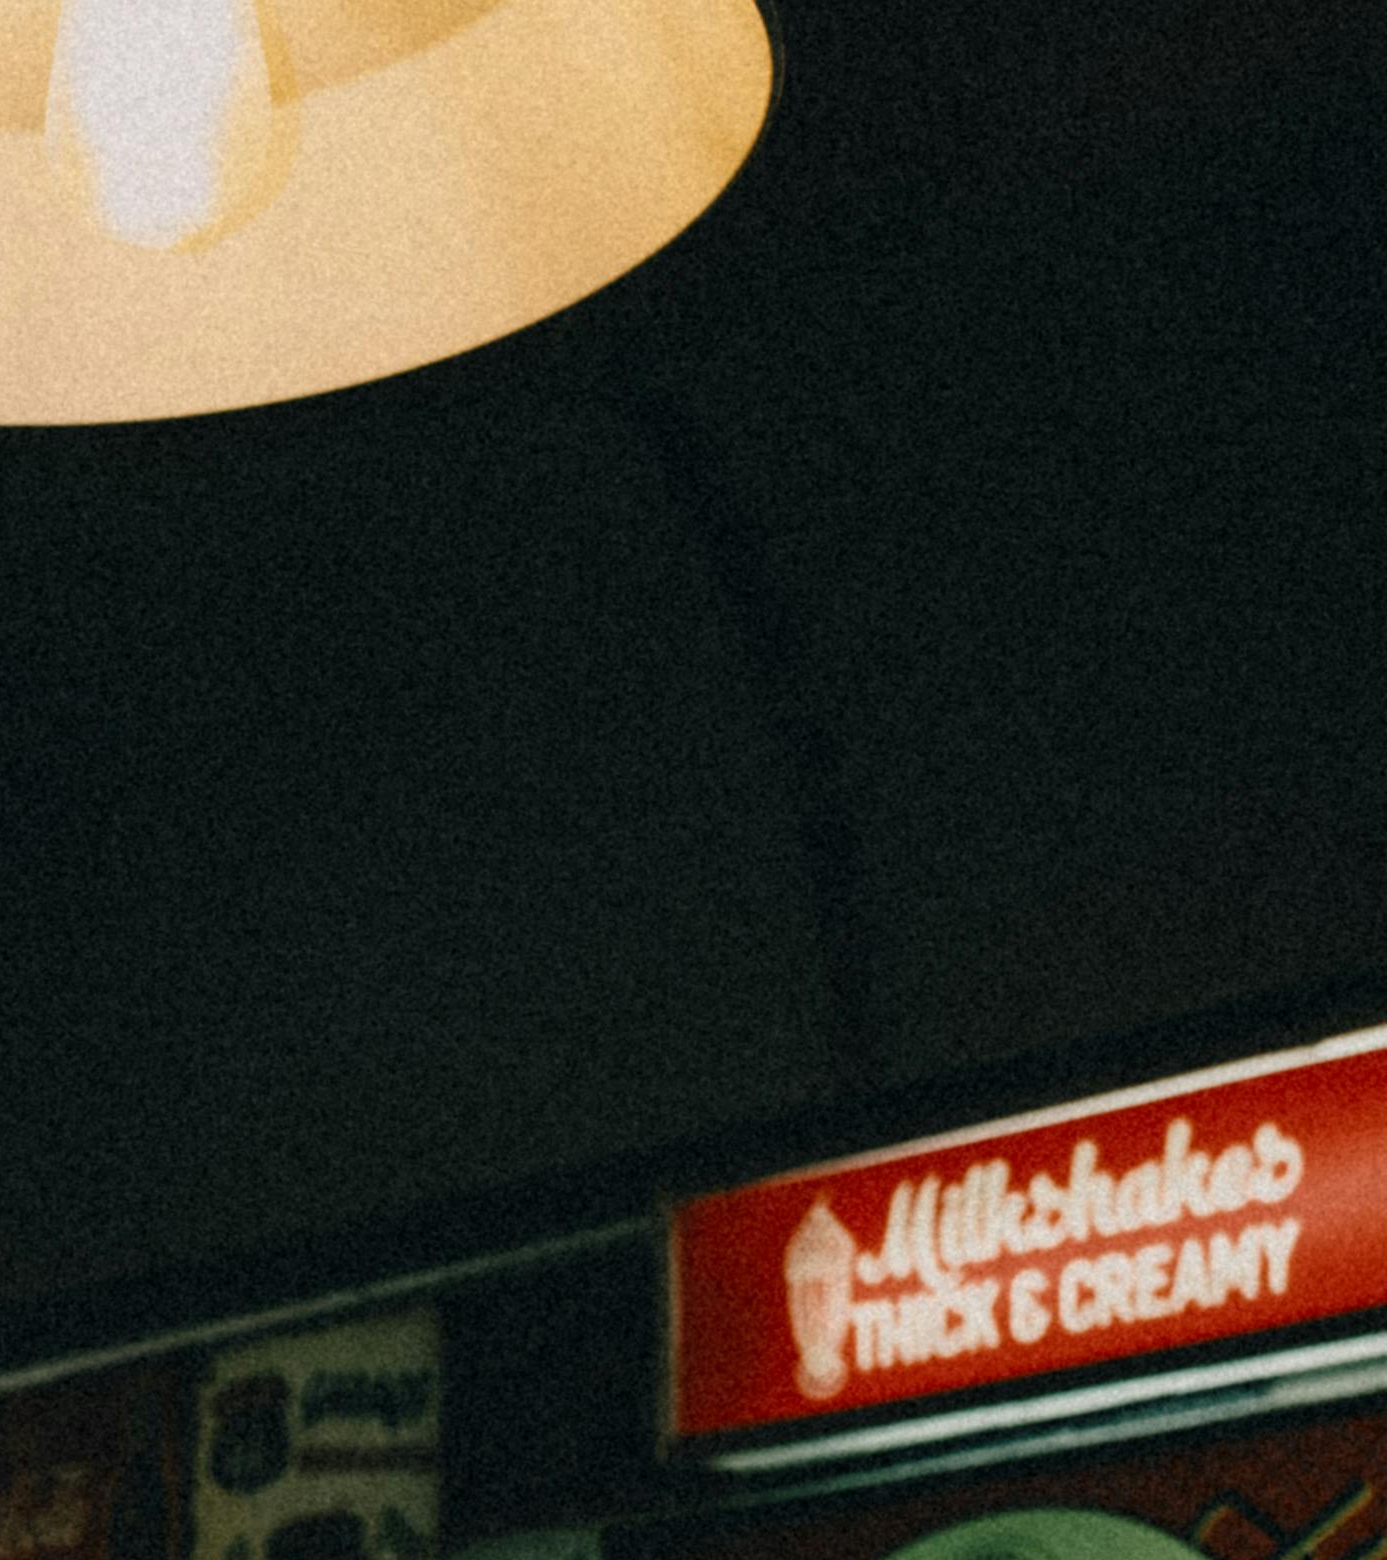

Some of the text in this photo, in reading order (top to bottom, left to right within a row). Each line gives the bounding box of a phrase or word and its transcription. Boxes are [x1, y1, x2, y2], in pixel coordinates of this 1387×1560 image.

[856, 1117, 1304, 1288] Milkshakes
[853, 1282, 1000, 1371] THICK
[1059, 1220, 1299, 1335] CREAMY
